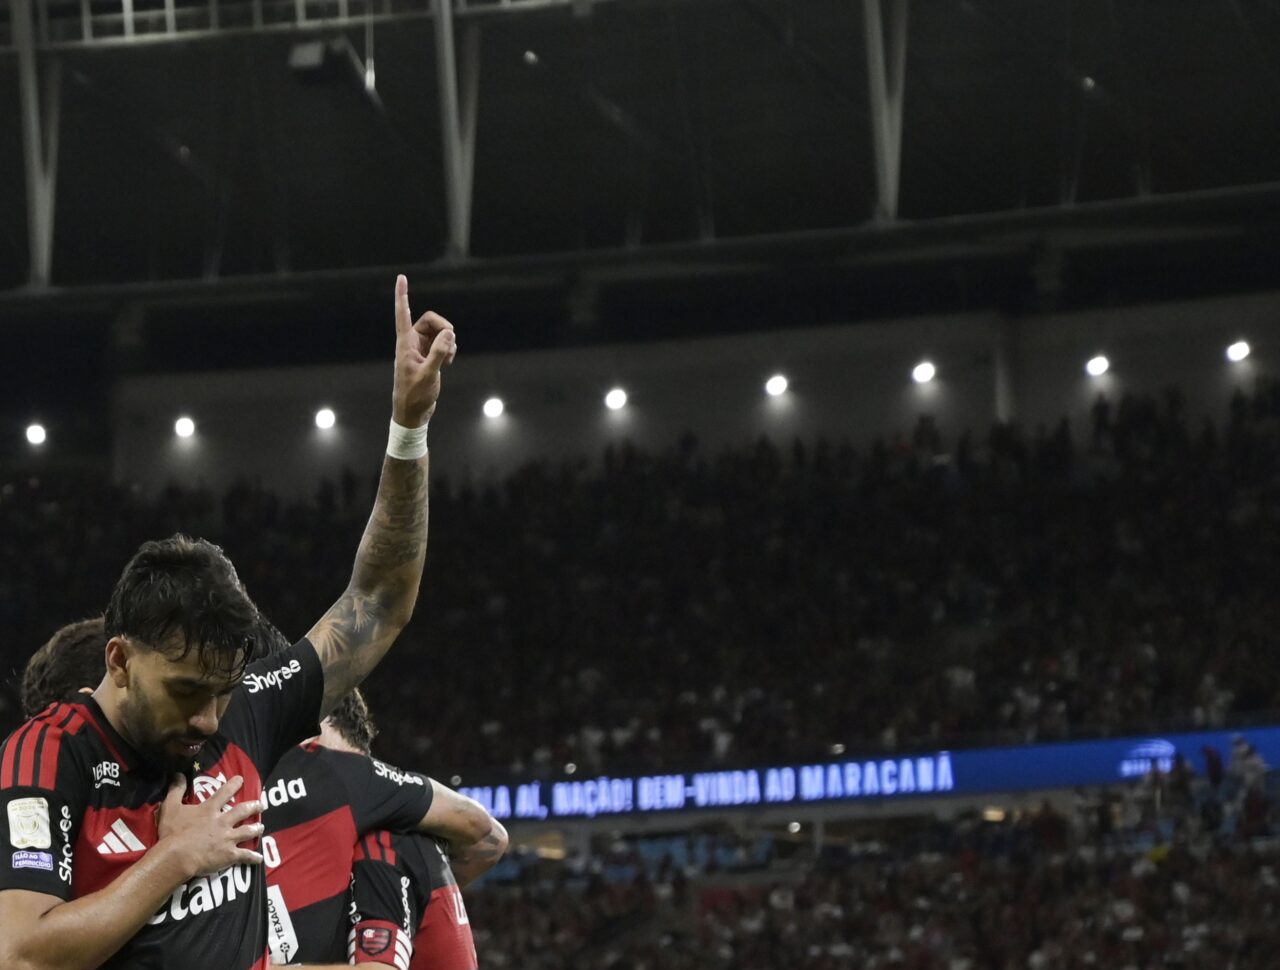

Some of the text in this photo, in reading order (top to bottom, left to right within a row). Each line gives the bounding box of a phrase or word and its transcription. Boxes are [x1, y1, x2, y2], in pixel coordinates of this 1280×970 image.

[242, 659, 301, 693] Shopee
[765, 767, 796, 801] AO
[799, 751, 955, 800] MARACANÃ
[58, 805, 73, 886] Shoee
[147, 864, 252, 925] tano
